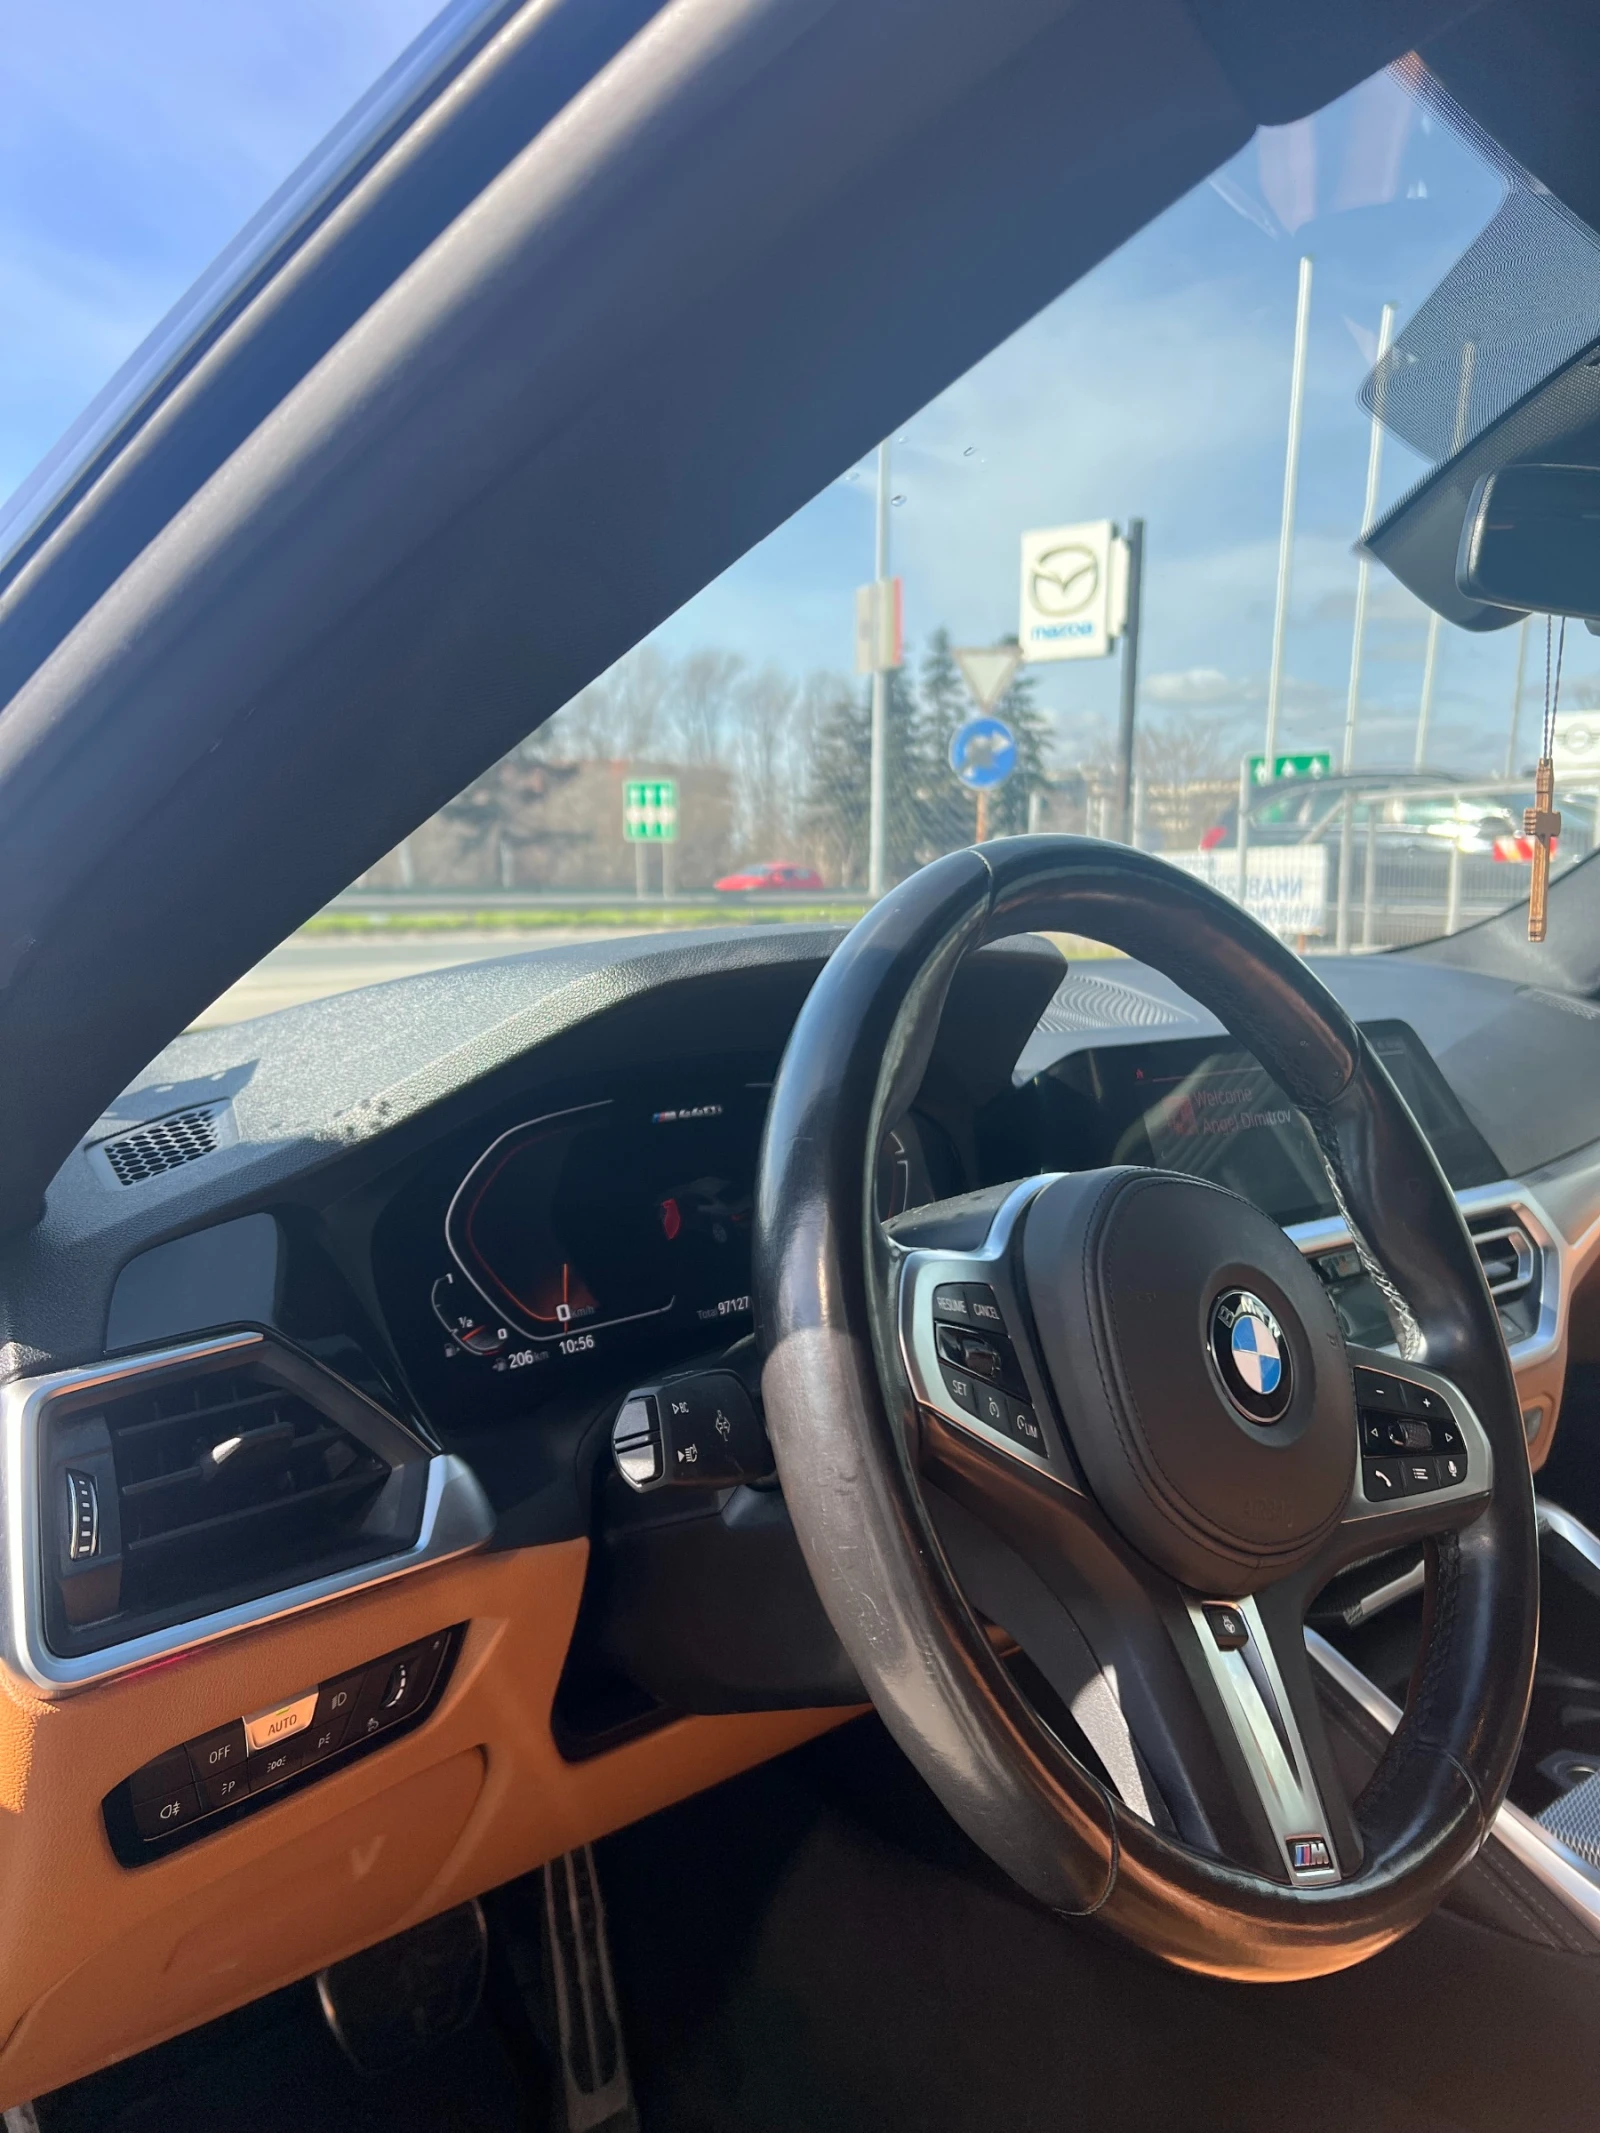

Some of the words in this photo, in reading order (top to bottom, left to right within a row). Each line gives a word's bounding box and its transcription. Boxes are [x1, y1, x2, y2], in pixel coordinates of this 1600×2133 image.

[1194, 1088, 1252, 1107] Welcome
[1203, 1115, 1239, 1133] Angel
[1240, 1110, 1291, 1127] Dimitrov
[556, 1303, 570, 1322] 0
[571, 1305, 595, 1318] km/h
[697, 1308, 718, 1320] Total
[718, 1296, 750, 1315] 97127
[936, 1296, 967, 1314] RESUME
[973, 1303, 1000, 1320] CANCEL
[1218, 1295, 1281, 1338] BMW
[559, 1334, 595, 1355] 10:56
[509, 1350, 533, 1370] 206
[533, 1350, 549, 1362] km
[952, 1379, 967, 1397] SET
[1025, 1424, 1038, 1438] LIM
[267, 1714, 297, 1735] AUTO
[209, 1744, 231, 1764] OFF
